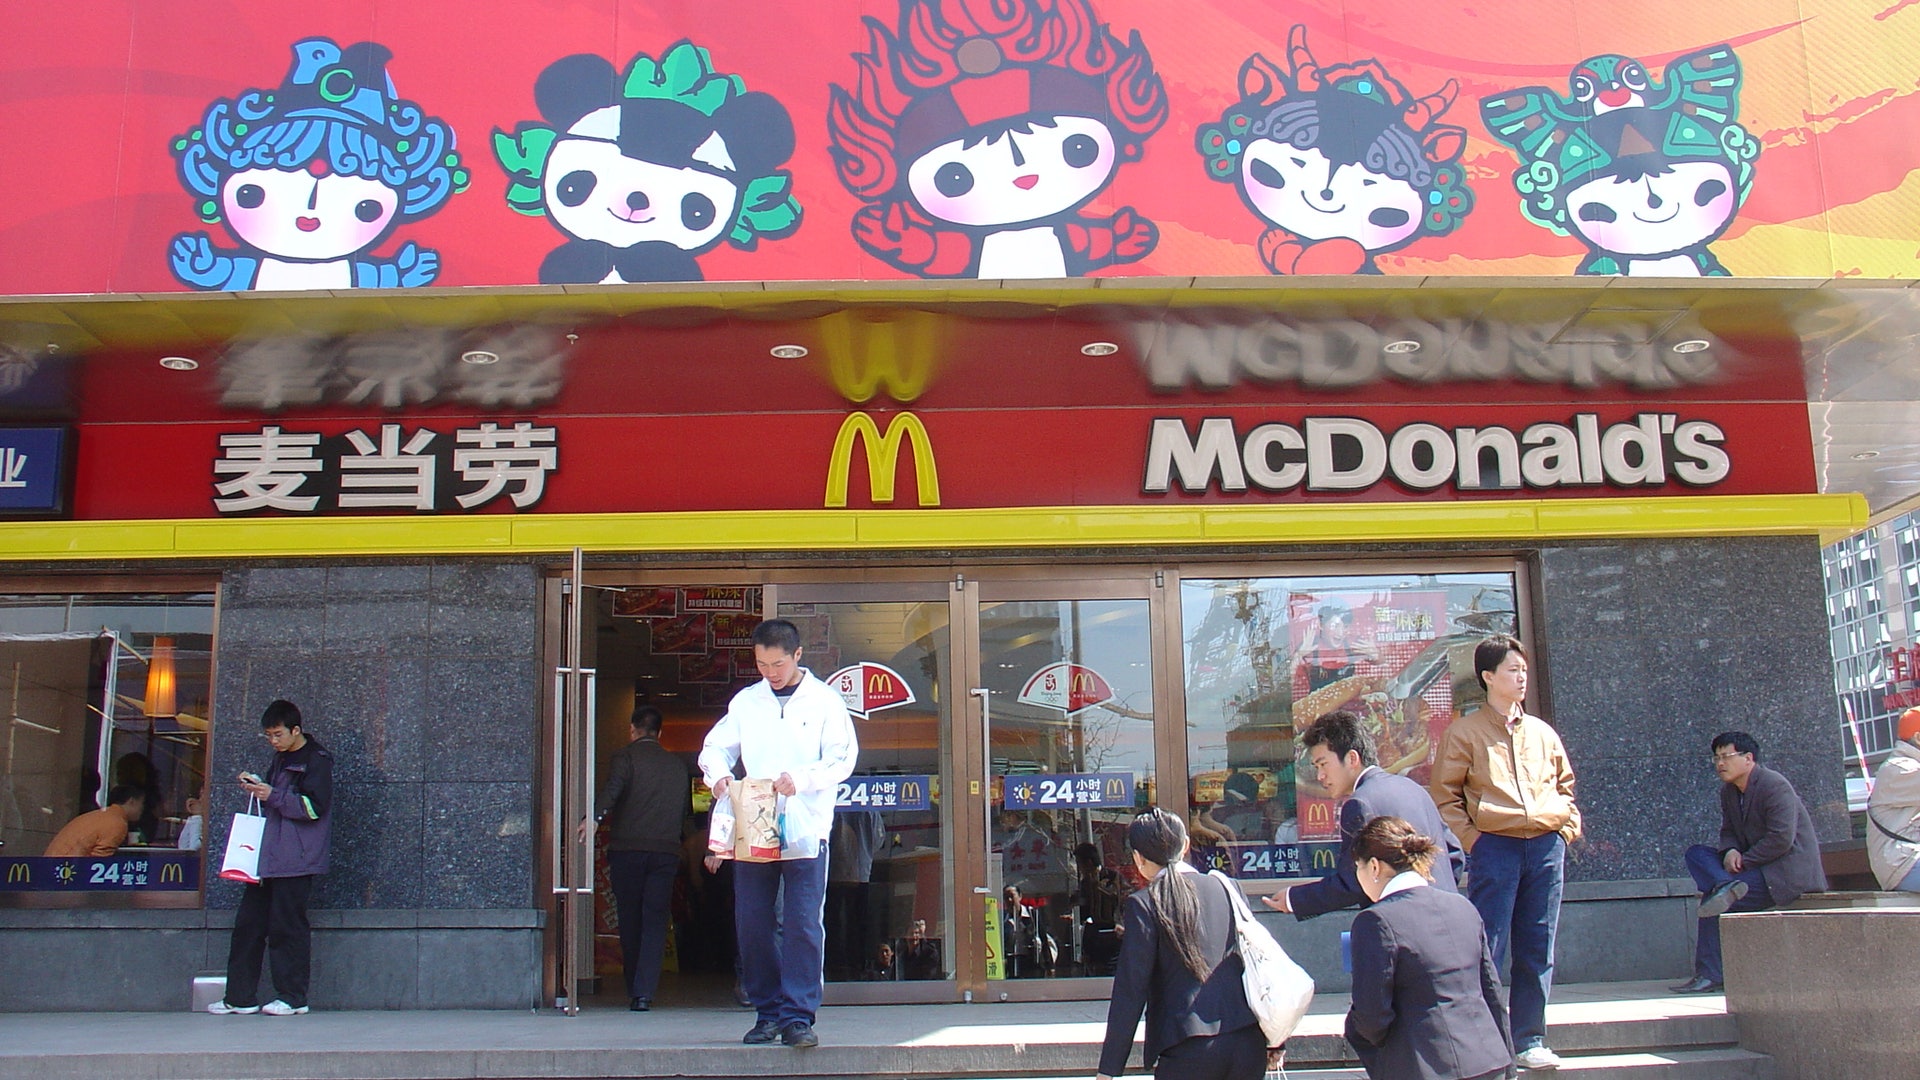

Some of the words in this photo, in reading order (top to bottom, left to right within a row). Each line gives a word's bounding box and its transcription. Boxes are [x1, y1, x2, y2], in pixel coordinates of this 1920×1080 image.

[1144, 413, 1731, 491] McDonald's
[214, 423, 557, 512] 麦当劳
[871, 782, 897, 794] 小时
[1076, 779, 1101, 791] 小时
[836, 783, 869, 806] 24
[1040, 780, 1074, 804] 24
[1076, 791, 1101, 803] 营业
[871, 794, 897, 806] 营业
[1274, 848, 1300, 861] 小时
[122, 860, 149, 873] 小时
[1242, 851, 1272, 872] 24
[1274, 860, 1301, 873] 营业
[89, 863, 120, 884] 24
[122, 873, 148, 886] 营业
